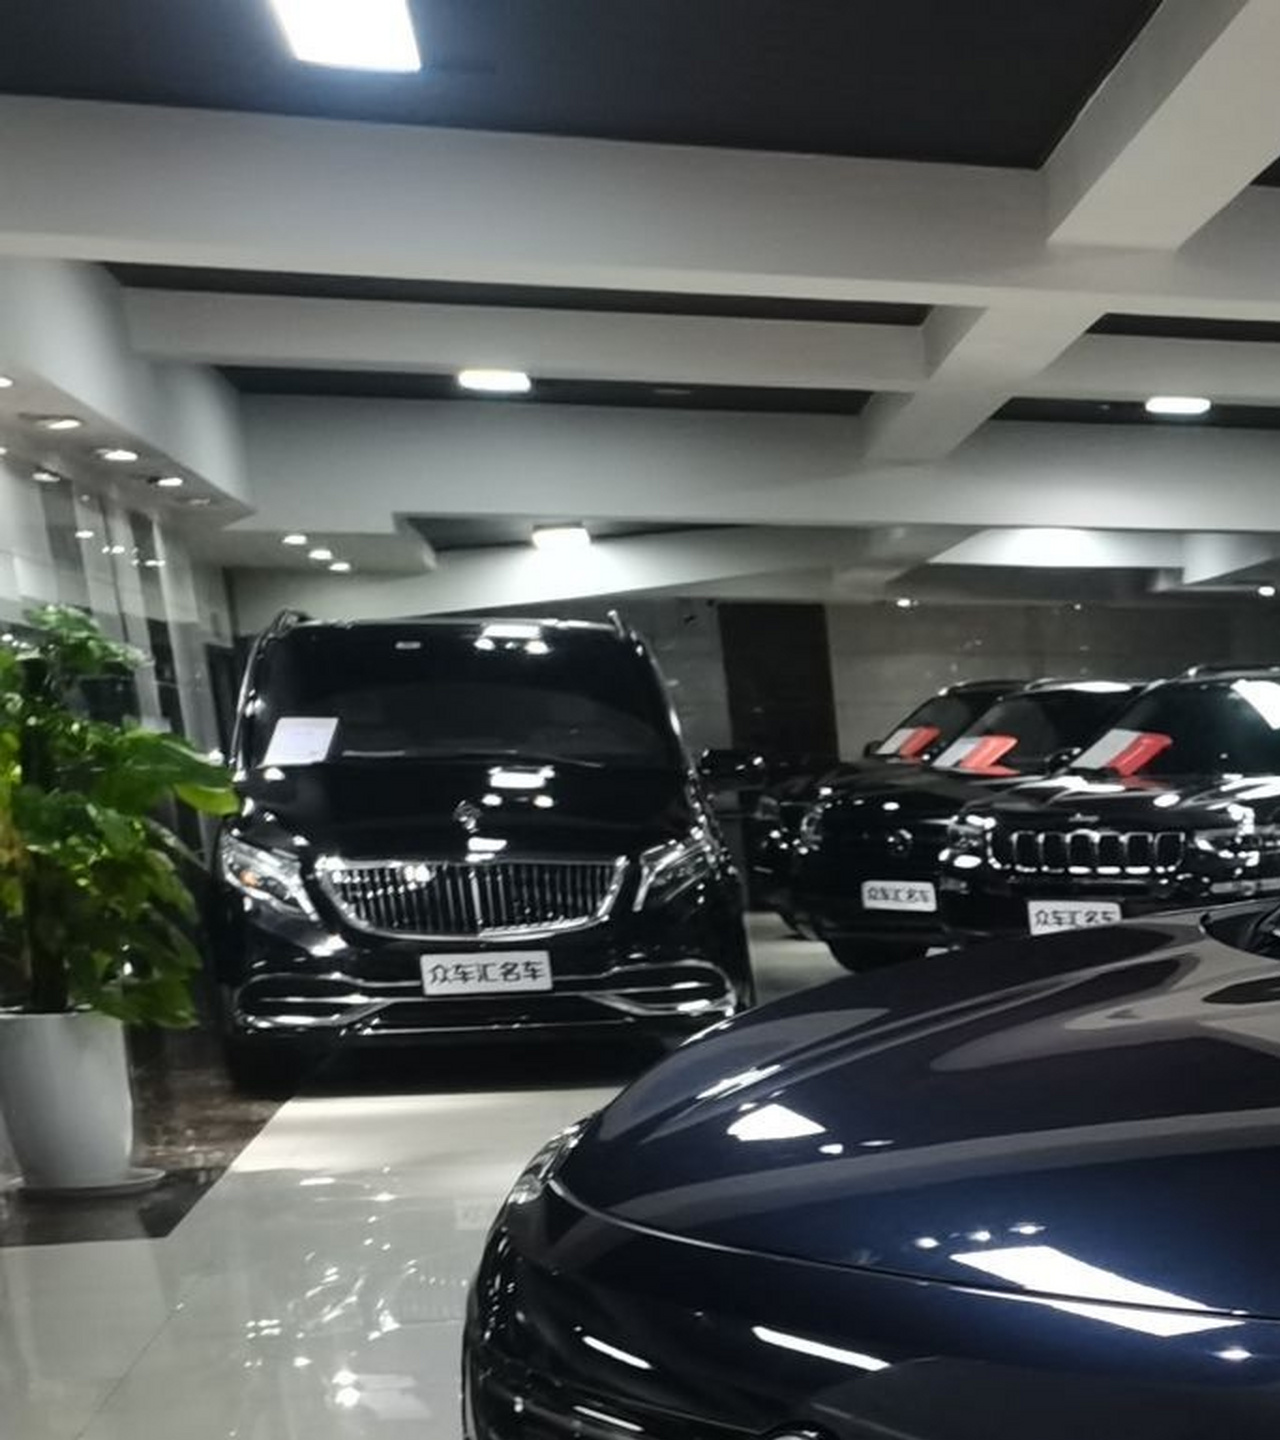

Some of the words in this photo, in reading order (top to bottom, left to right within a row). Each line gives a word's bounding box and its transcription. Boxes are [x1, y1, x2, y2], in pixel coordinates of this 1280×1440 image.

[429, 960, 545, 985] 众车汇名车
